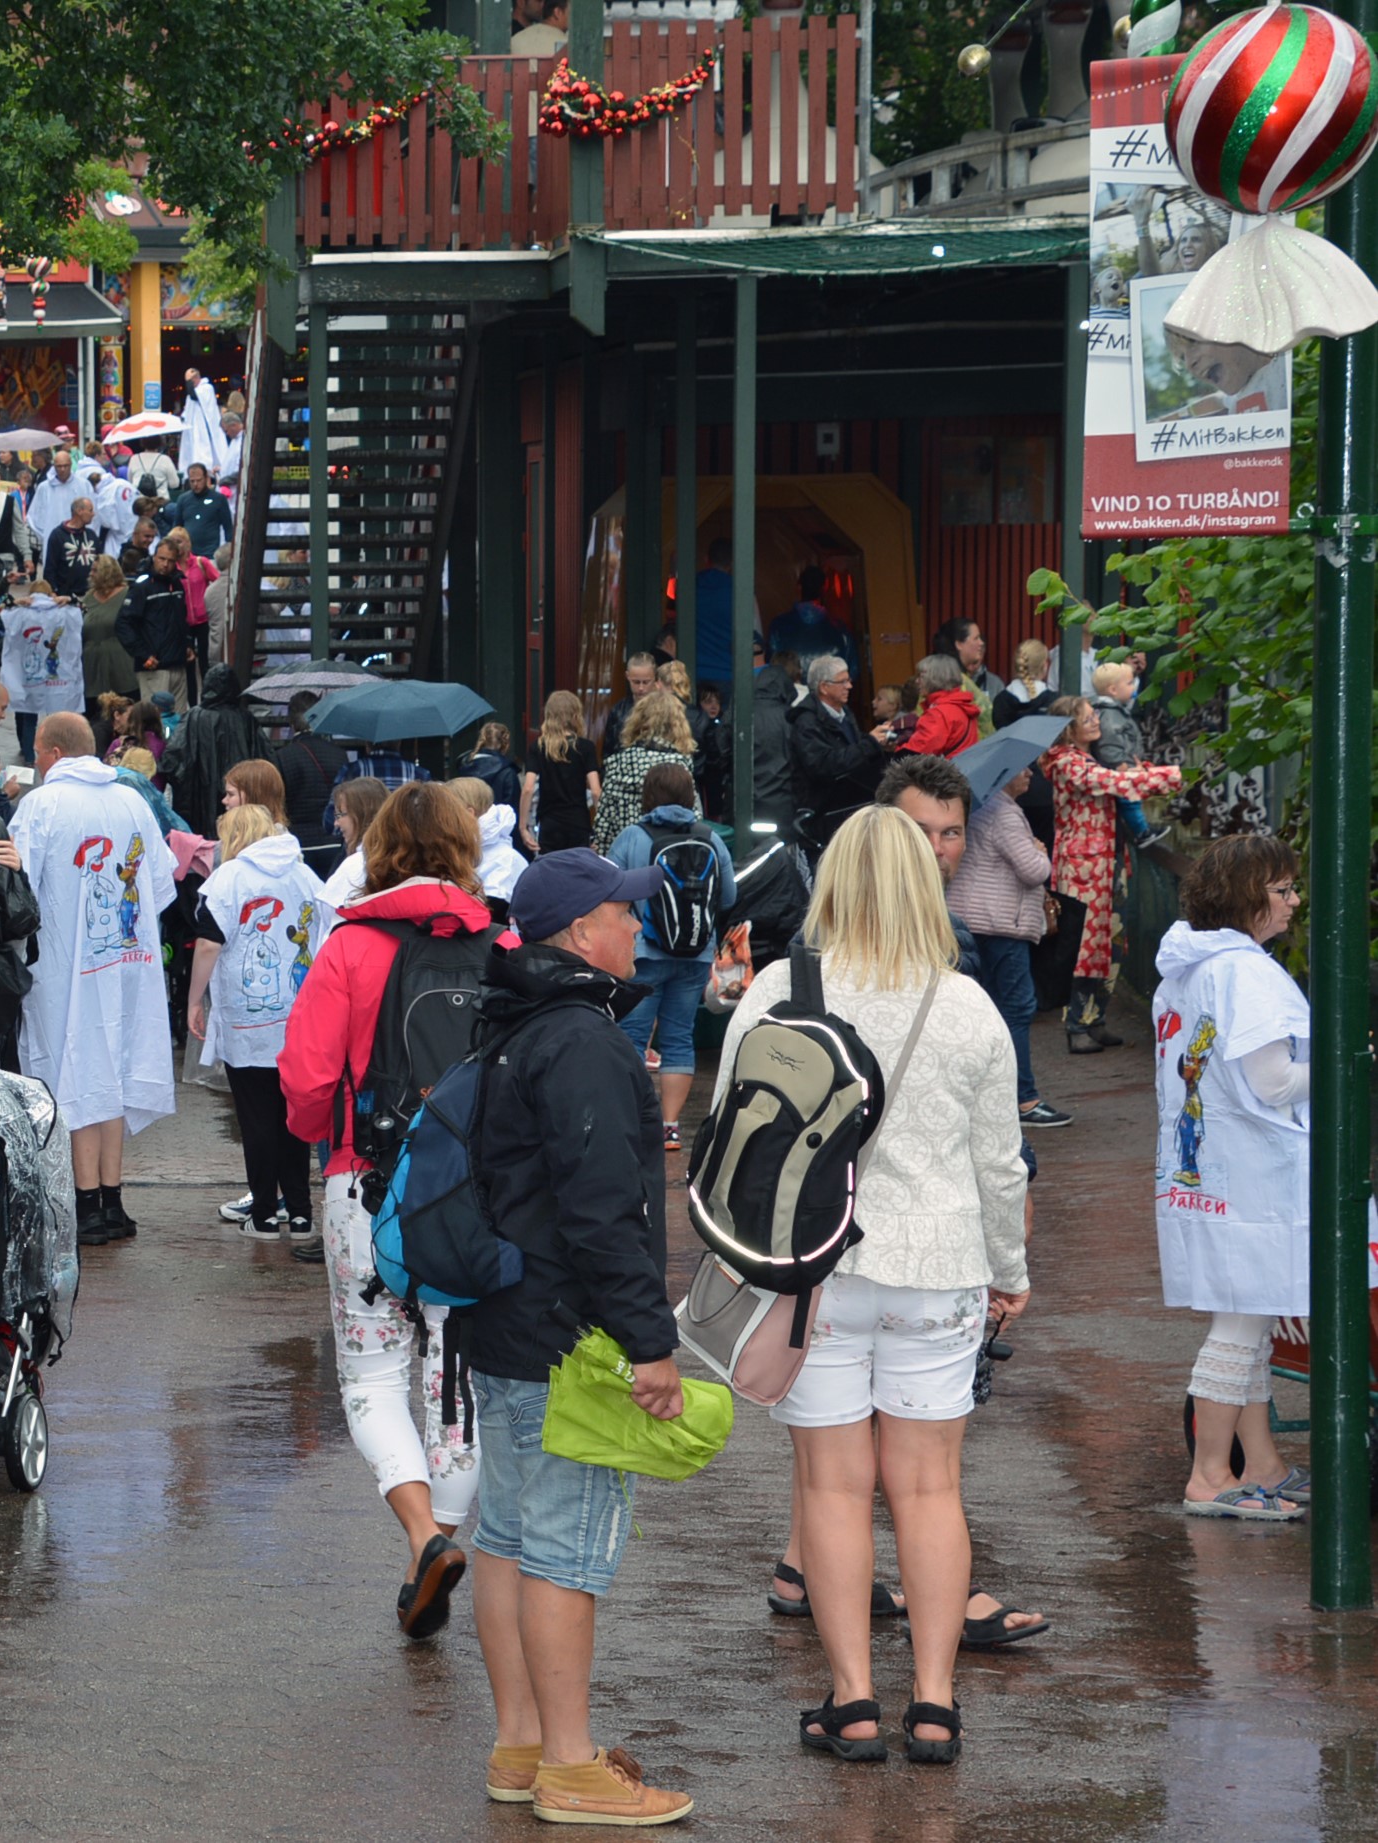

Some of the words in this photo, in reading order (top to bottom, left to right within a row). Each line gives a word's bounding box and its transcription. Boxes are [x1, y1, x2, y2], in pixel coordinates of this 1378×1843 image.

[1151, 422, 1285, 453] #MitBakken
[1223, 456, 1283, 470] @bakkendk
[1091, 495, 1140, 513] VIND
[1177, 487, 1280, 510] TURBÅND!
[1094, 514, 1276, 530] www.bakken.dk/instagram
[1169, 1186, 1226, 1215] Bakken
